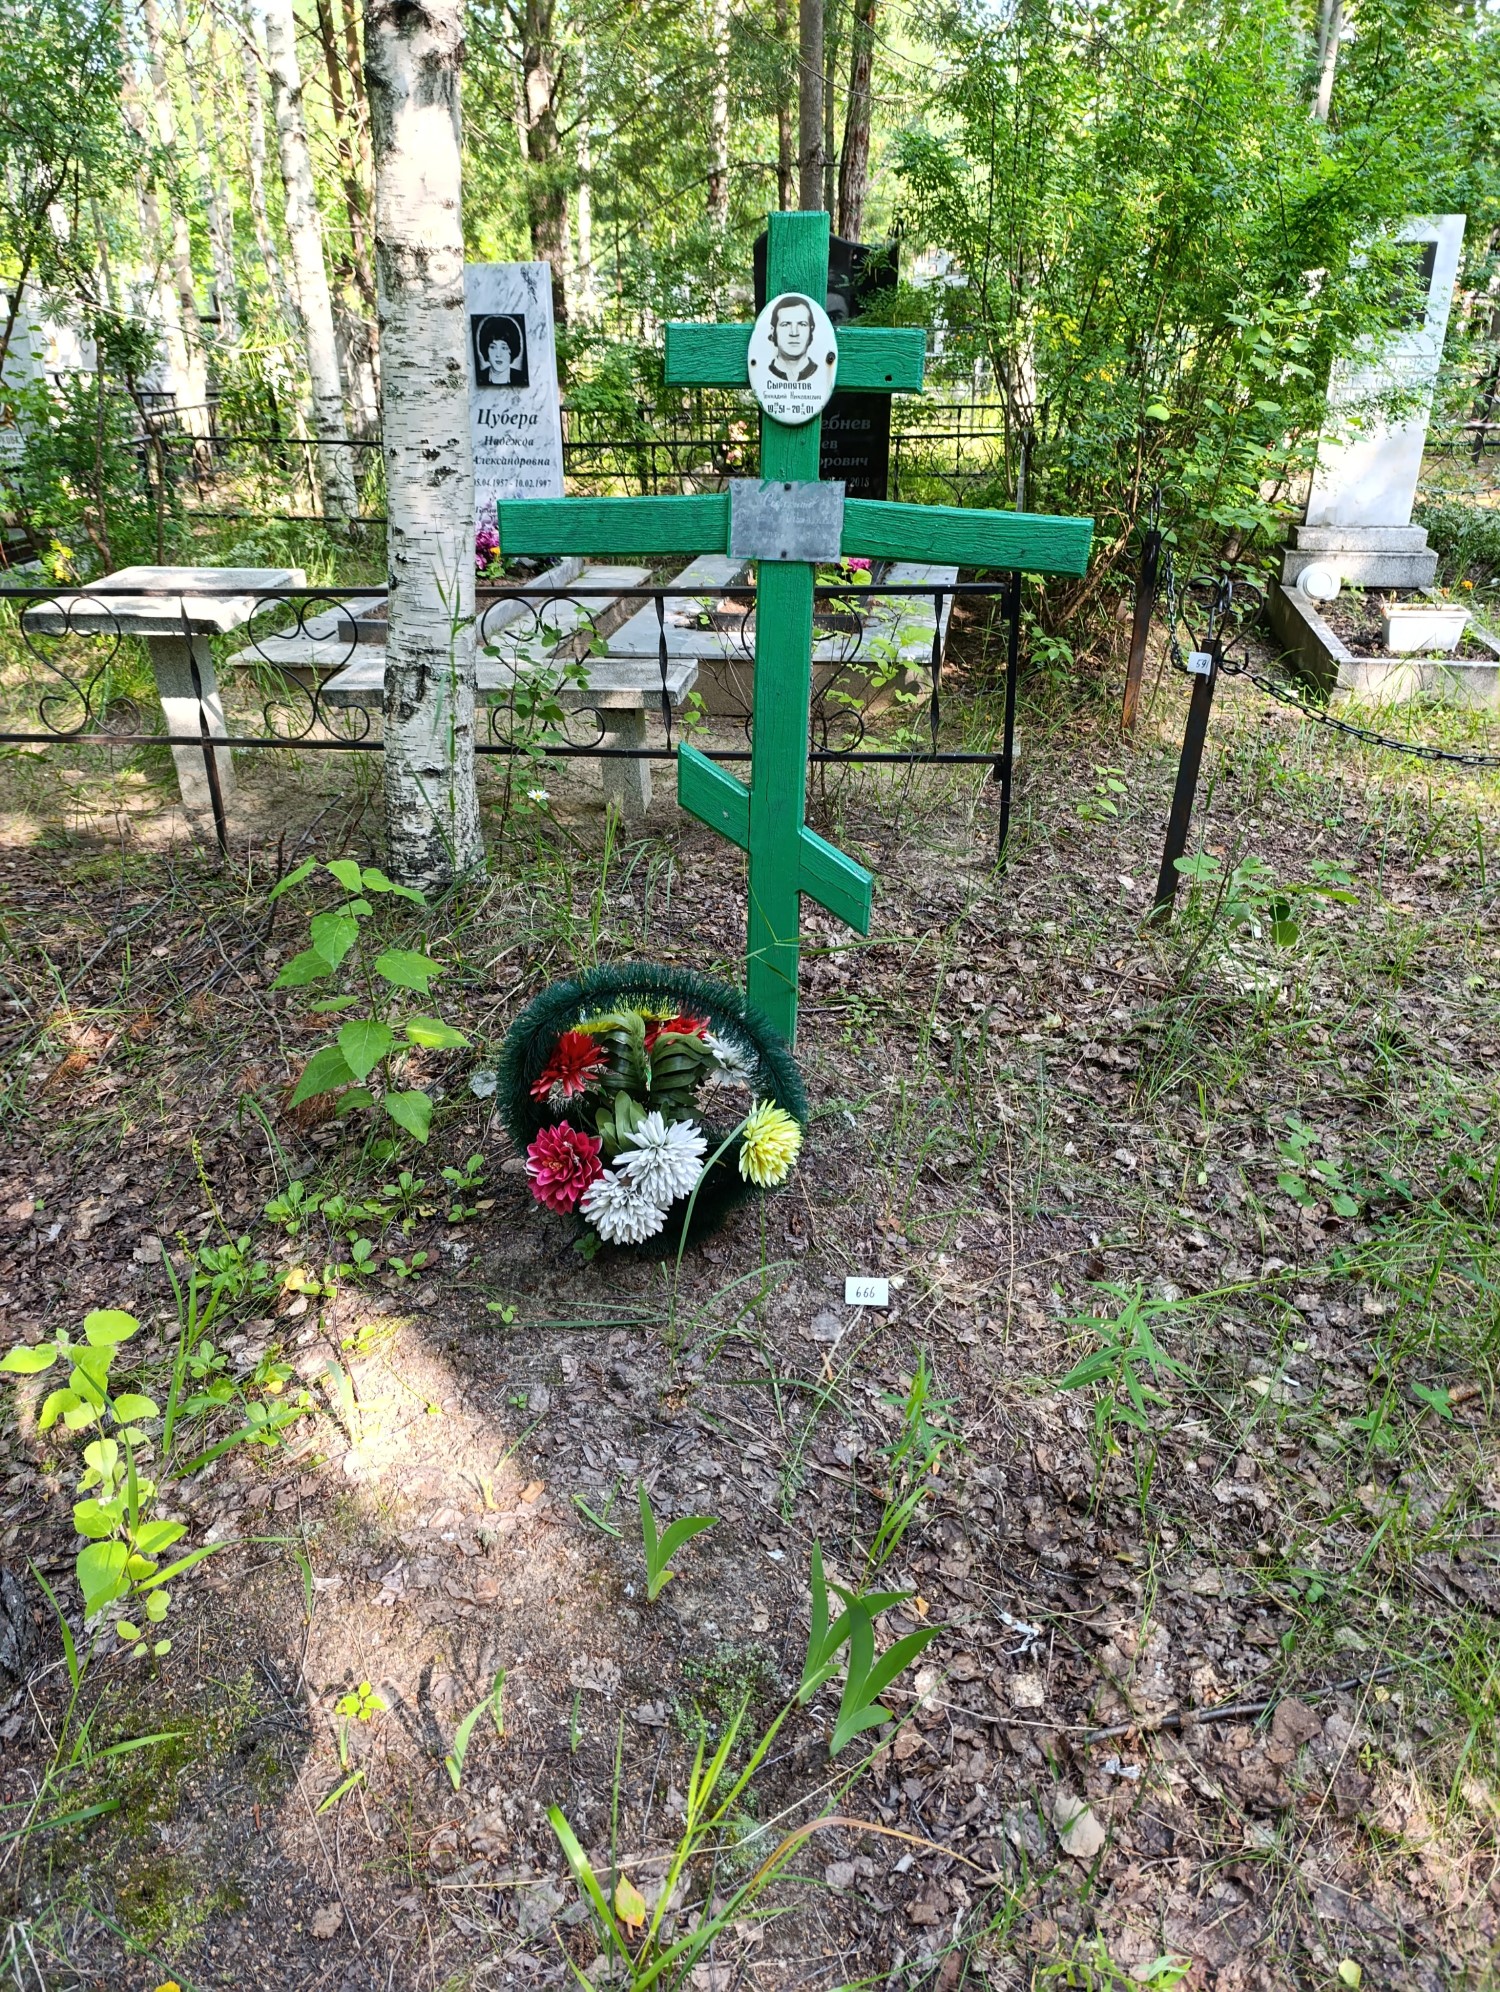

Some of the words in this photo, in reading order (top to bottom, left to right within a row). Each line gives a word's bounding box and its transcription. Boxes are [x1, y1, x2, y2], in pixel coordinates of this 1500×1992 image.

[477, 408, 538, 429] Цубера
[821, 413, 871, 430] ебнев
[484, 435, 534, 448] Надежда
[821, 440, 838, 449] ев
[474, 455, 550, 468] Александровна
[819, 457, 869, 468] рович
[856, 1286, 875, 1298] 666
